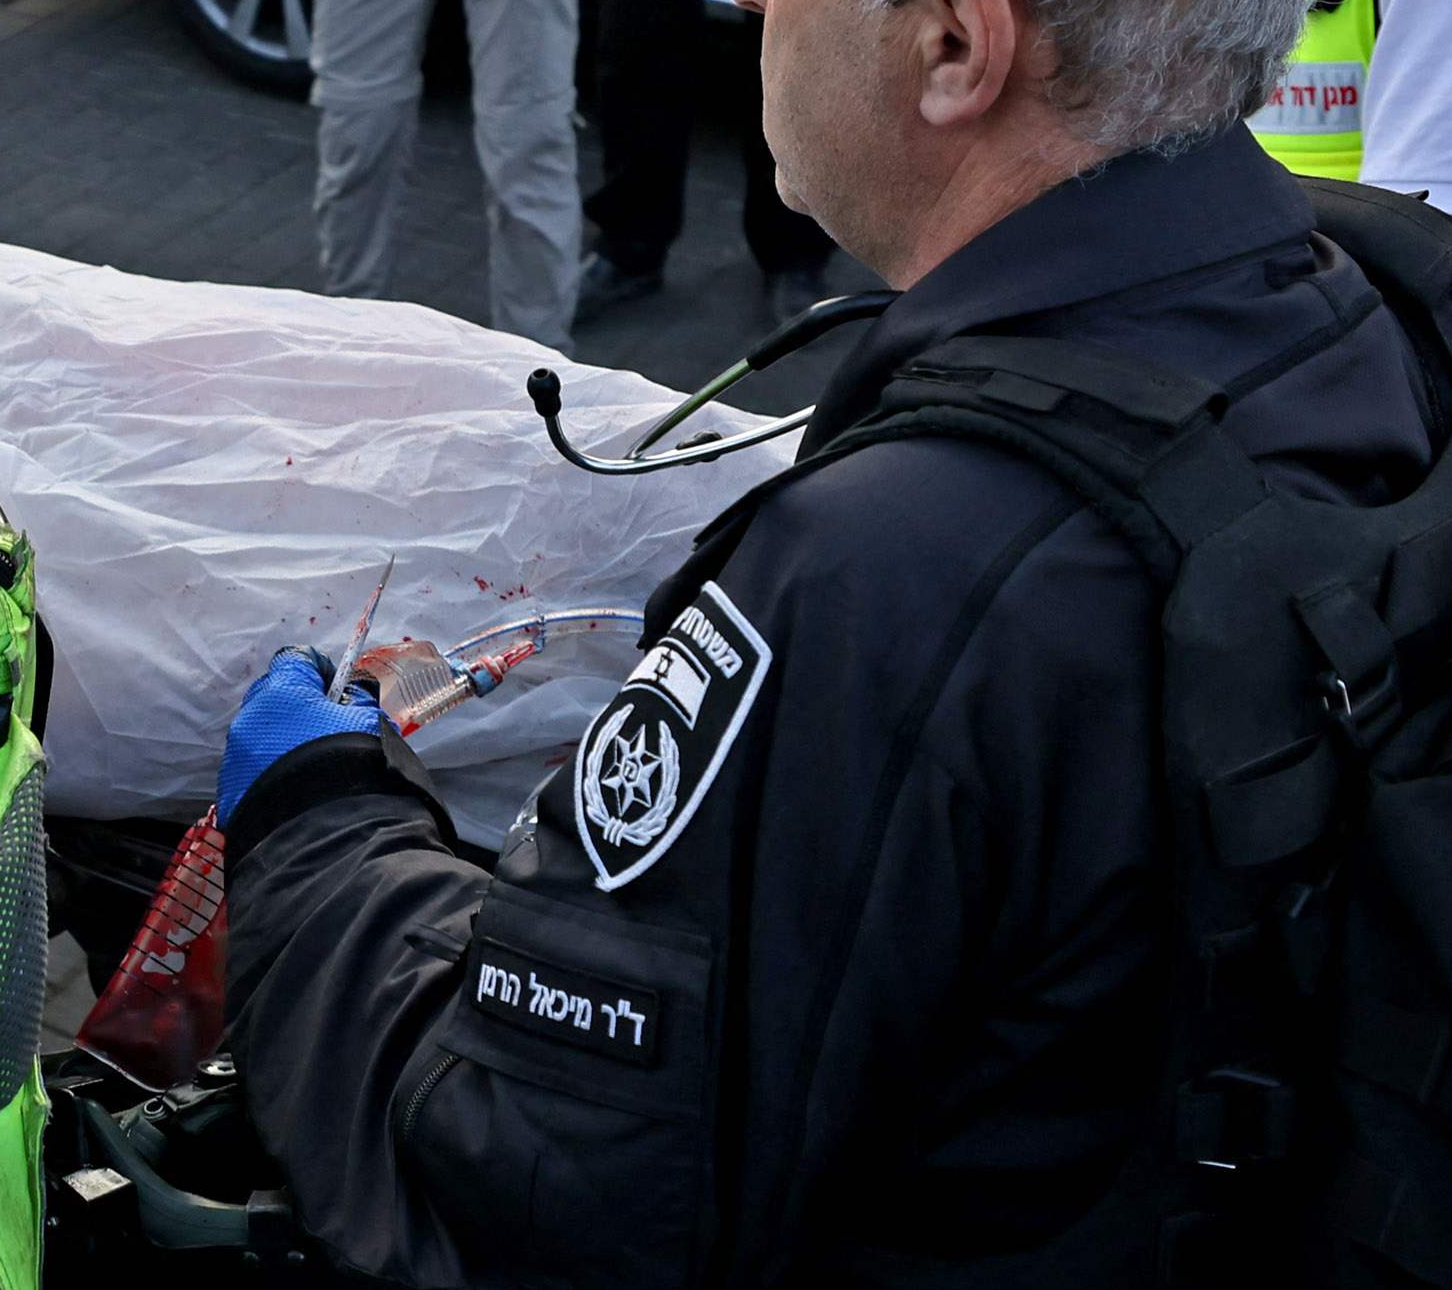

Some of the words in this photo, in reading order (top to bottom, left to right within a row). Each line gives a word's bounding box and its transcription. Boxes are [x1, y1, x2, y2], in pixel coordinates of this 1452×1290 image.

[1290, 85, 1317, 107] דוד
[1323, 85, 1358, 111] מגן
[476, 963, 522, 1007] הרמן
[528, 972, 593, 1031] מיכאל
[600, 998, 646, 1046] ד"ר
